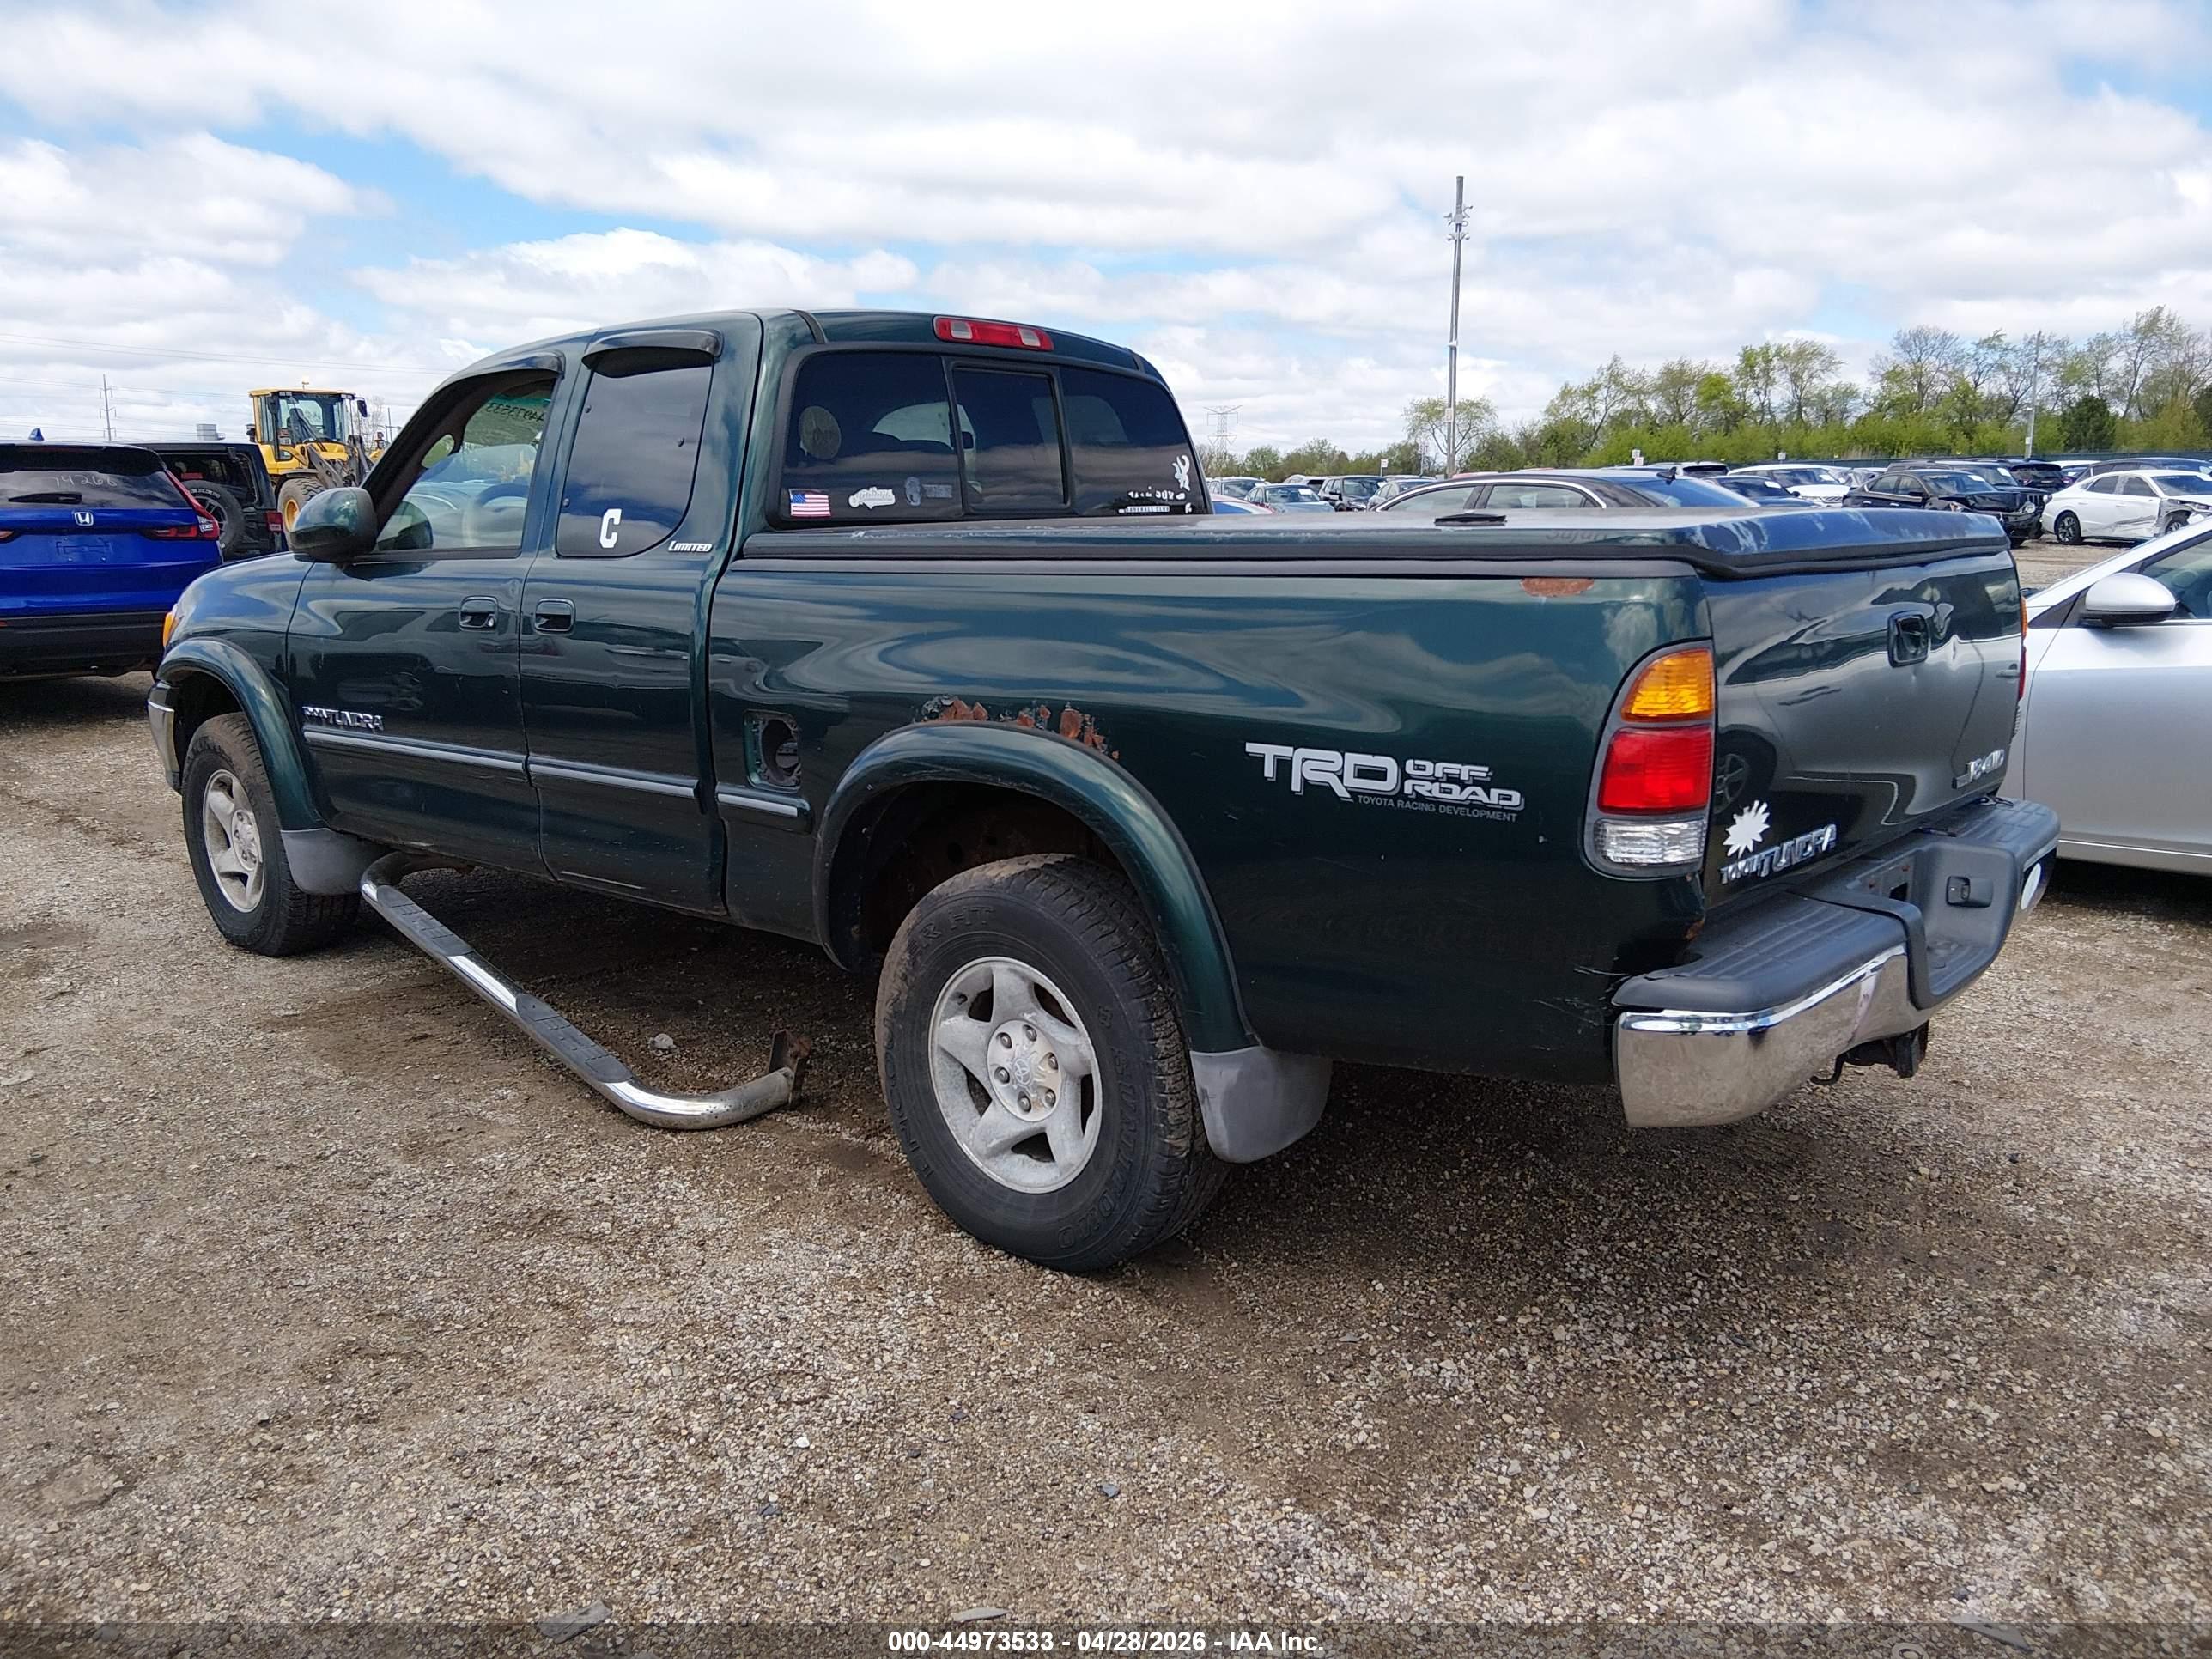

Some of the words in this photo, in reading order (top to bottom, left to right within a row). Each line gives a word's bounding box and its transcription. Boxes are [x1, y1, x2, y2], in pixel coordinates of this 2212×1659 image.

[599, 508, 622, 548] C
[1244, 741, 1401, 803] TRD
[1404, 757, 1492, 782] OFF
[1358, 793, 1395, 809] TOYOTA
[1396, 799, 1437, 814] RACING
[1437, 804, 1517, 823] DEVELOPMENT
[1403, 779, 1525, 811] ROAD
